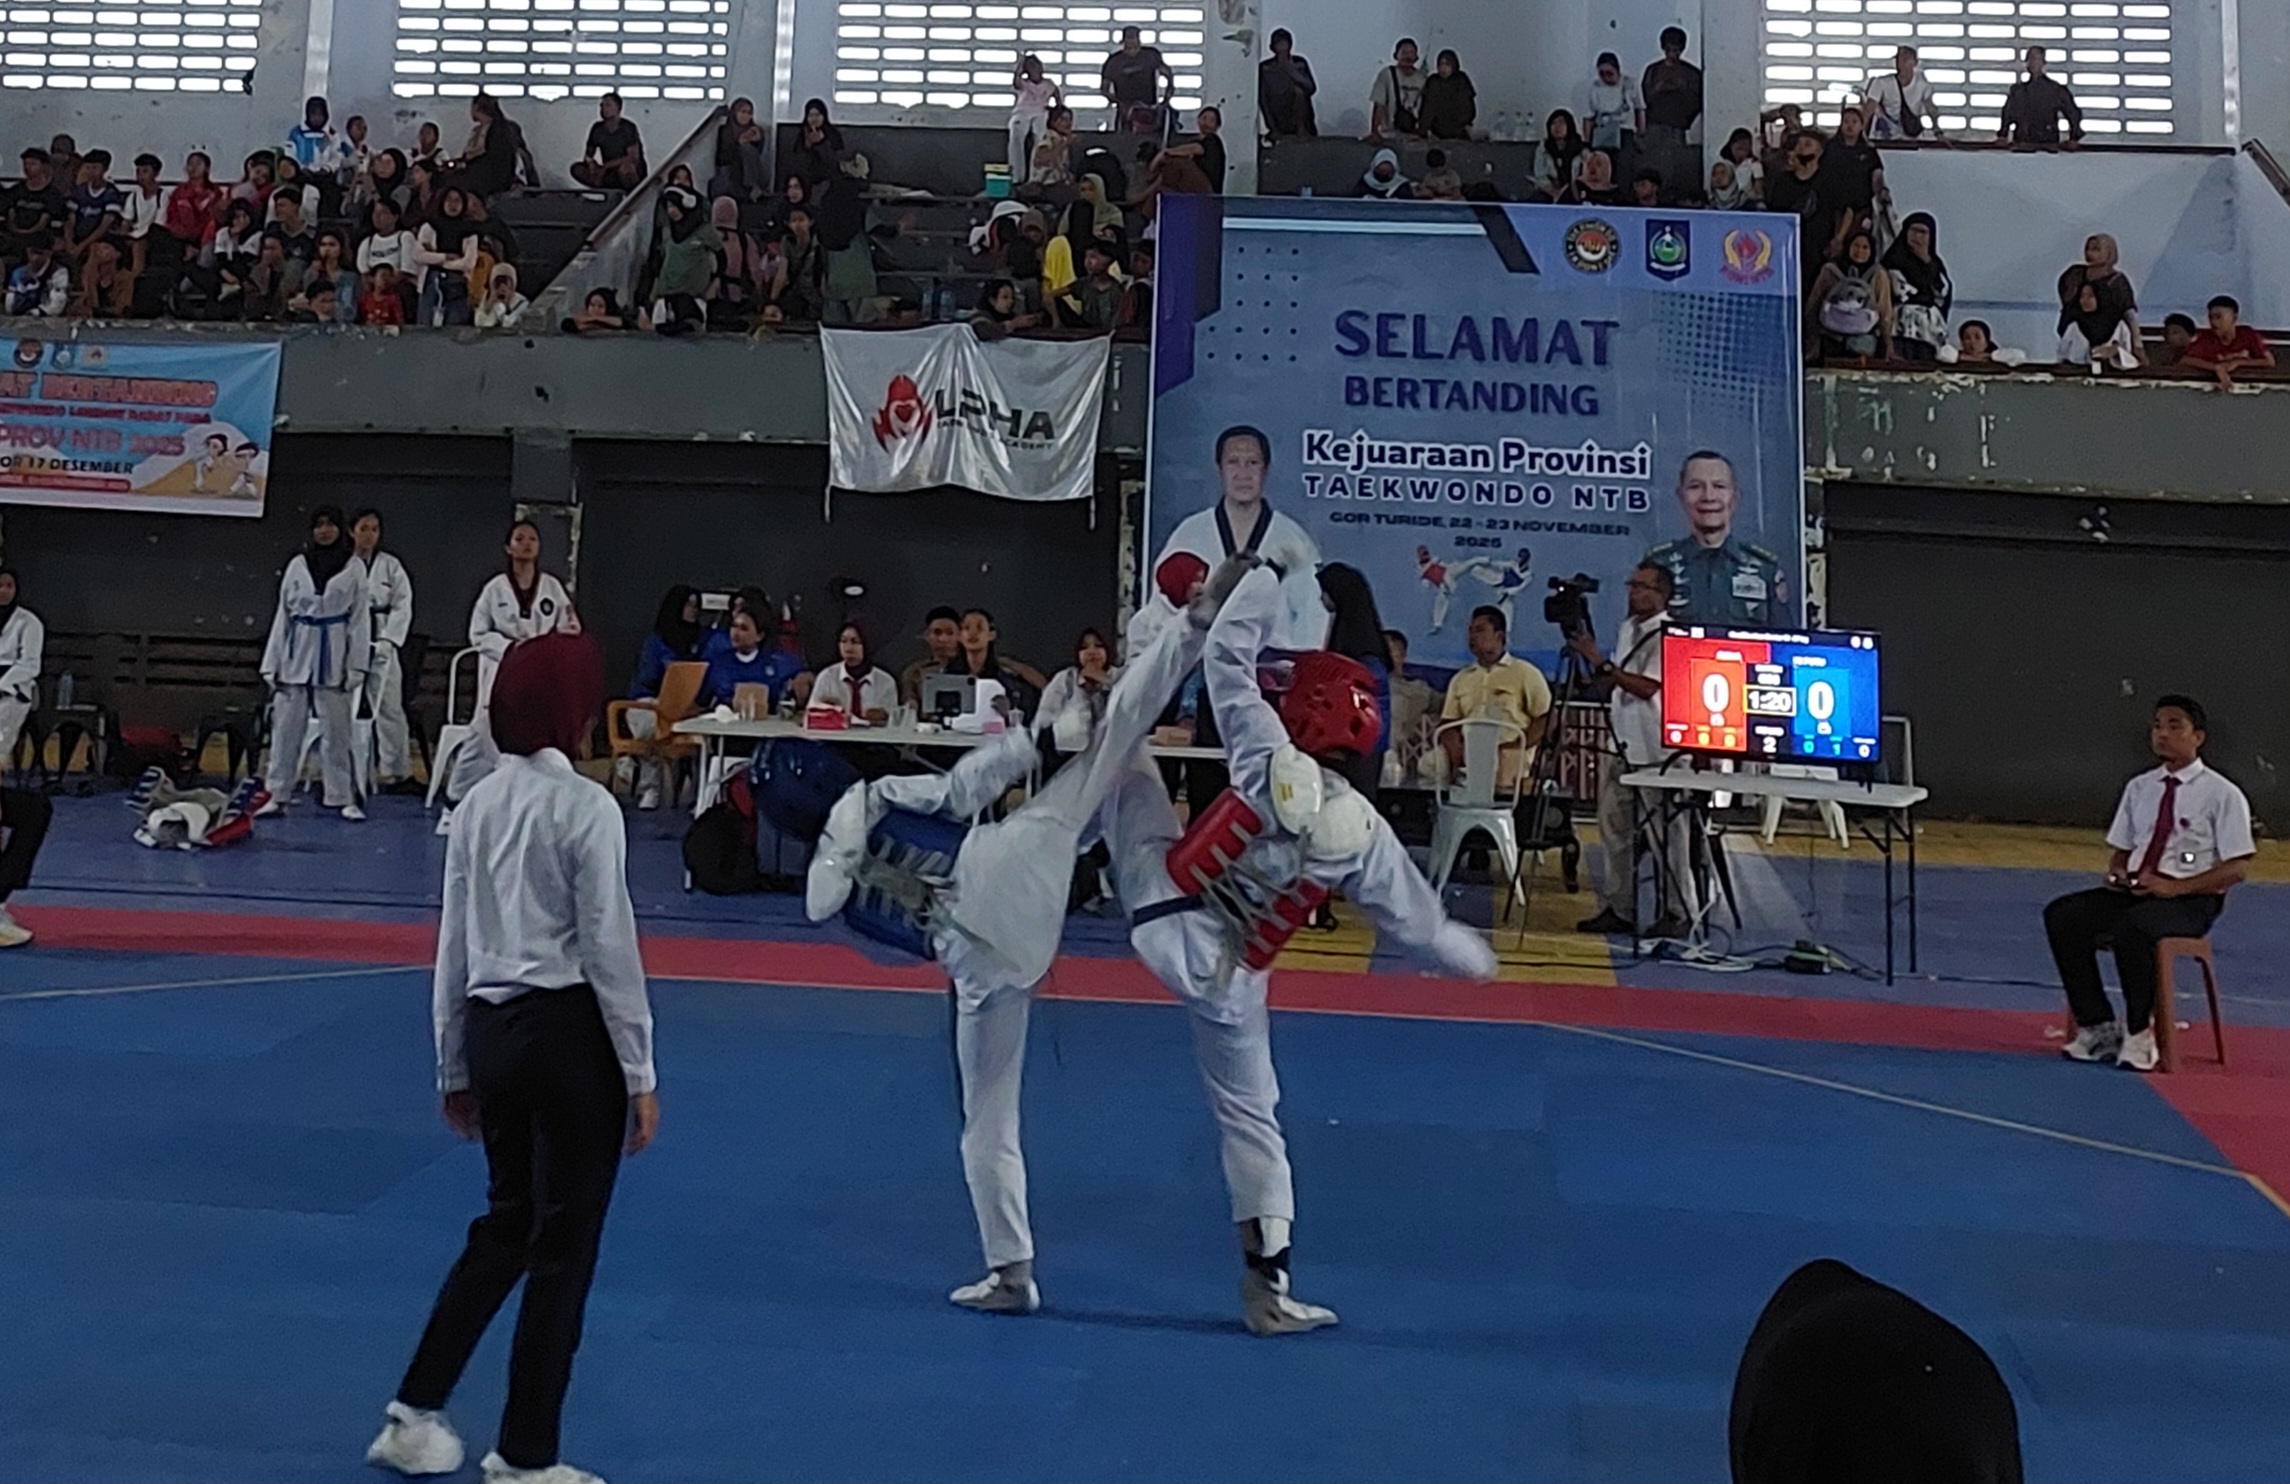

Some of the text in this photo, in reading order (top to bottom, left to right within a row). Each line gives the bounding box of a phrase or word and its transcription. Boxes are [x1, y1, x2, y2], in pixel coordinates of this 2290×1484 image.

[1335, 309, 1620, 366] SELAMAT
[1345, 376, 1600, 416] BERTANDING
[28, 457, 46, 469] 17
[50, 459, 134, 475] DESEMBER
[1303, 431, 1650, 478] Kejuaraan Provinsi
[1304, 475, 1649, 511] TAEKWONDO NTB
[1329, 512, 1371, 524] GOR
[1449, 516, 1473, 529] 22
[1486, 518, 1510, 531] 23
[1513, 520, 1631, 537] NOVEMBER
[1702, 673, 1730, 712] 0
[1748, 690, 1792, 712] 1:20
[1807, 680, 1835, 721] 0
[1763, 736, 1777, 752] 2
